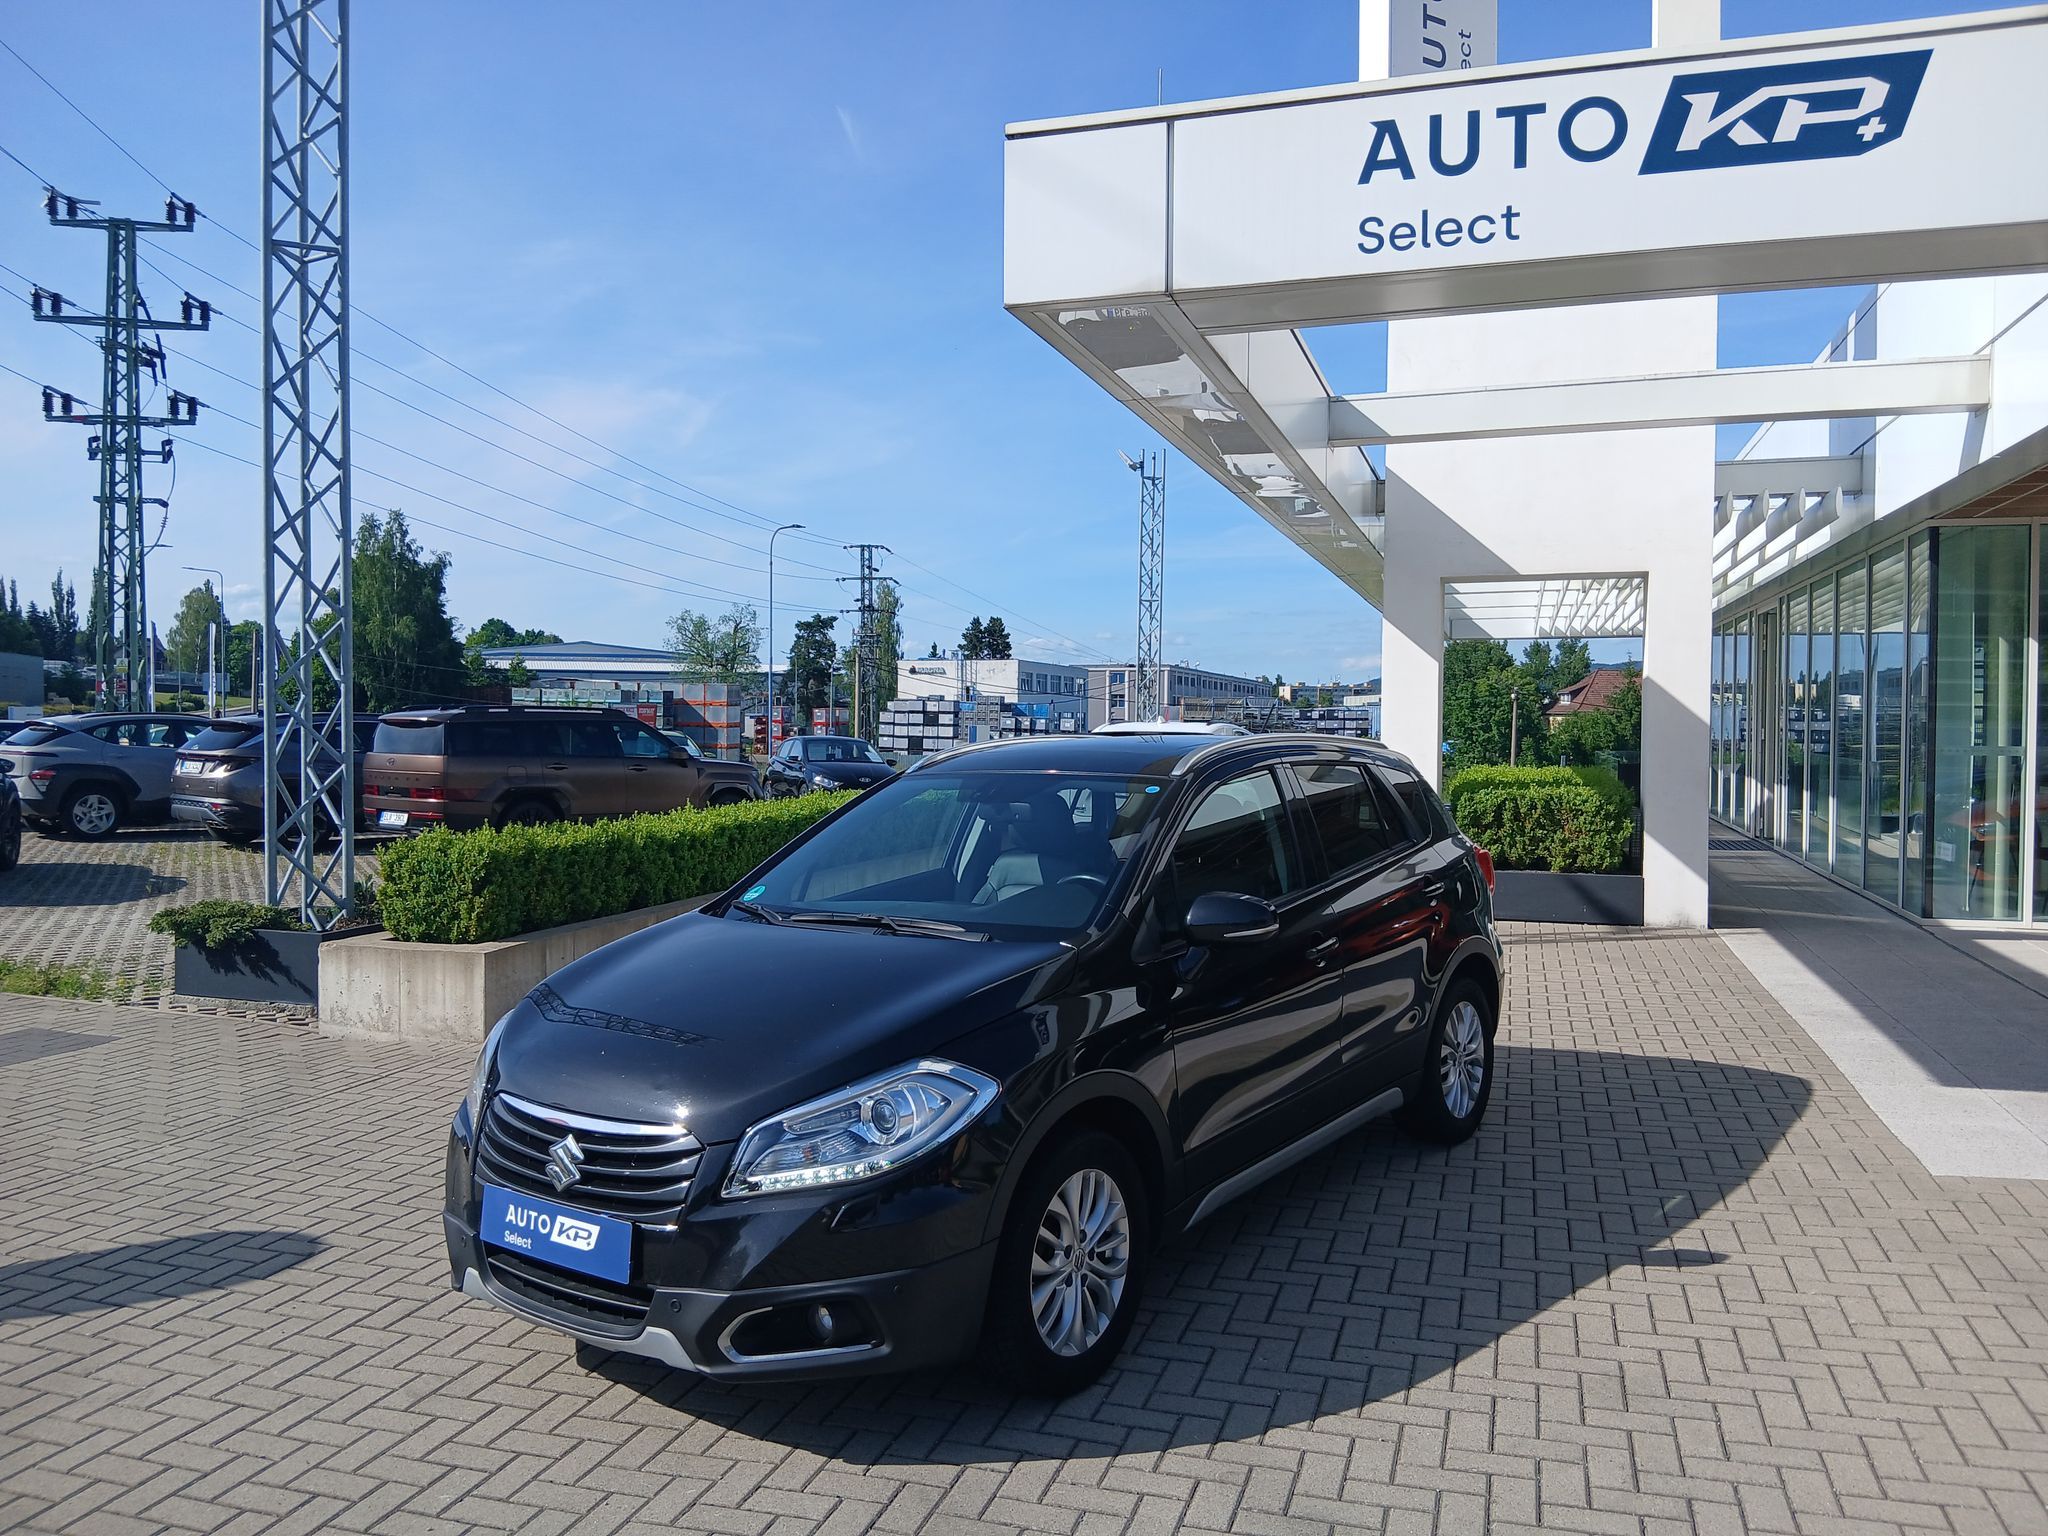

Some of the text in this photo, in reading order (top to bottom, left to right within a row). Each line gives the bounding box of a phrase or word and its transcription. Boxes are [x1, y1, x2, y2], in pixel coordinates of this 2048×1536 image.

[1357, 97, 1629, 185] AUTO
[1357, 204, 1521, 254] Select
[505, 1204, 551, 1234] AUTO
[504, 1230, 532, 1250] Select
